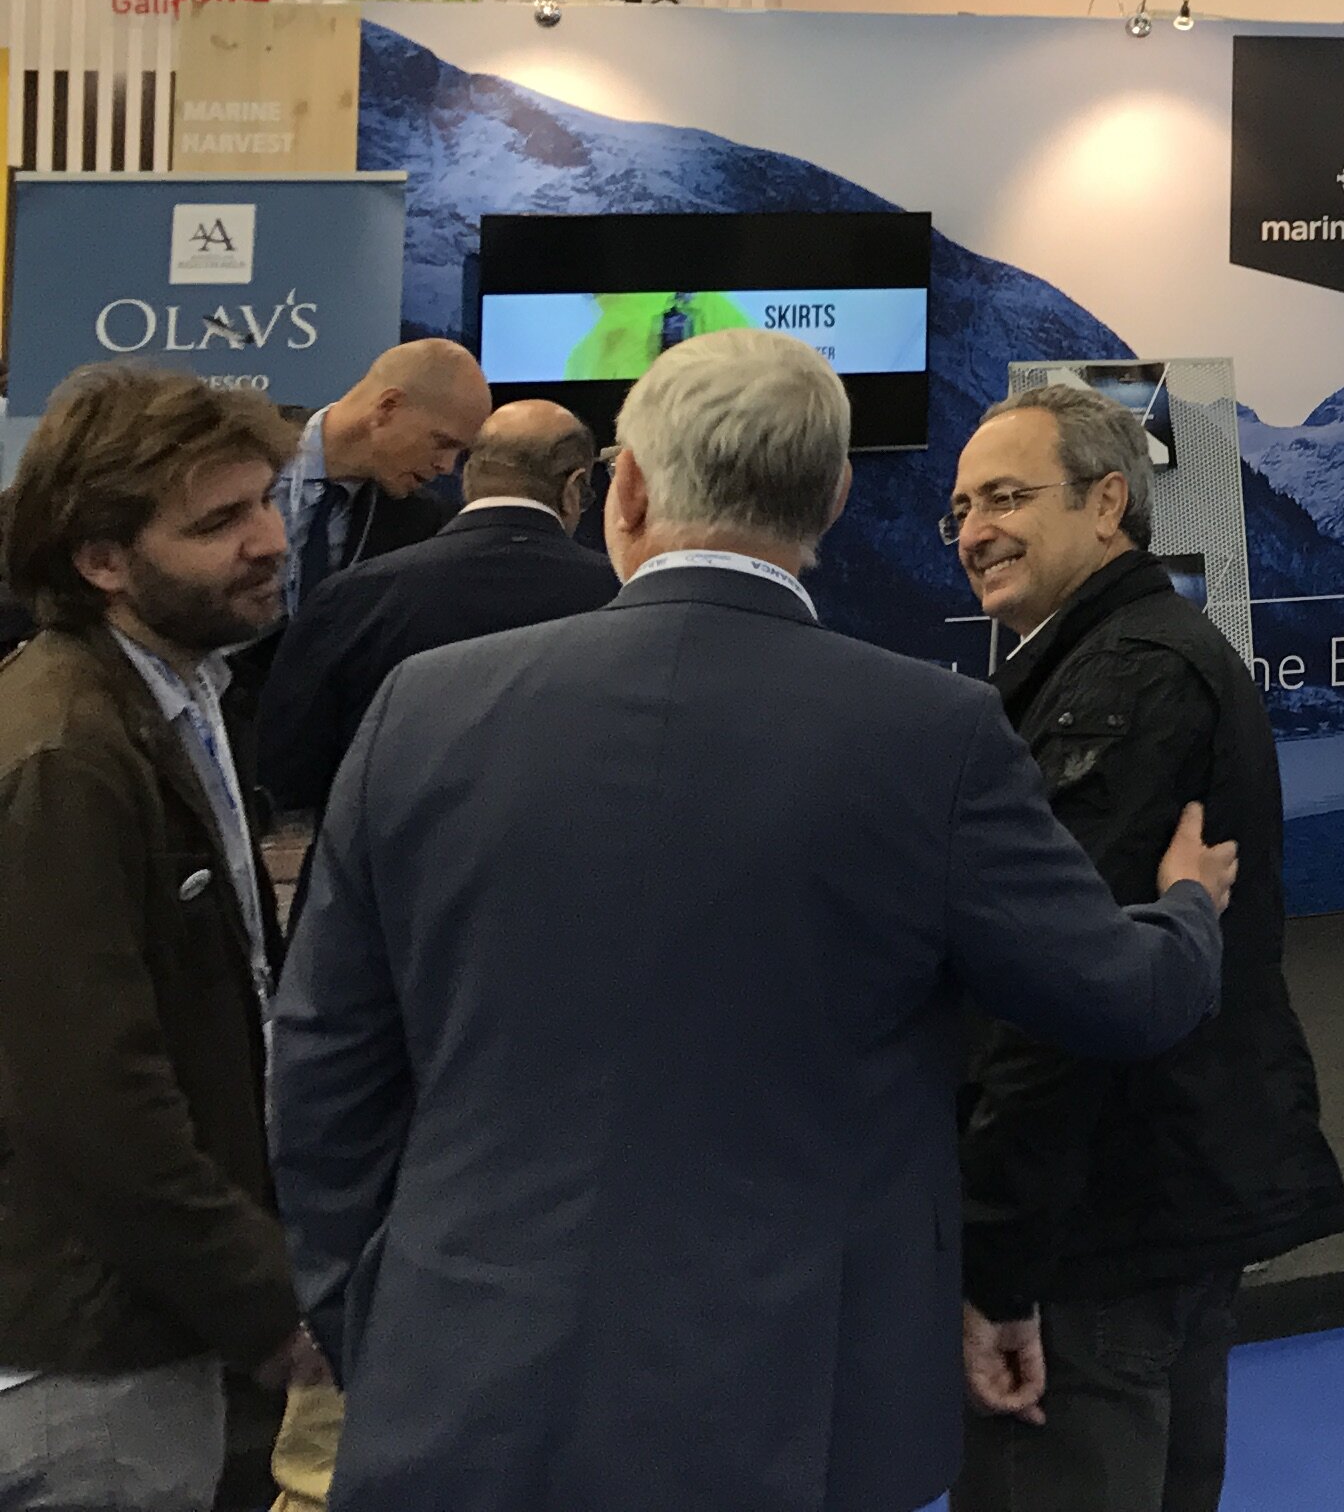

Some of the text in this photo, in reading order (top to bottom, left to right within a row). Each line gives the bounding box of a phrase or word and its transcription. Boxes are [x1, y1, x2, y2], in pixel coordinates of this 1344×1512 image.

[183, 100, 282, 122] MARINE
[181, 132, 295, 154] HARVEST
[95, 287, 318, 352] OLAV'S
[764, 303, 836, 329] SKIRTS
[1250, 654, 1306, 692] he
